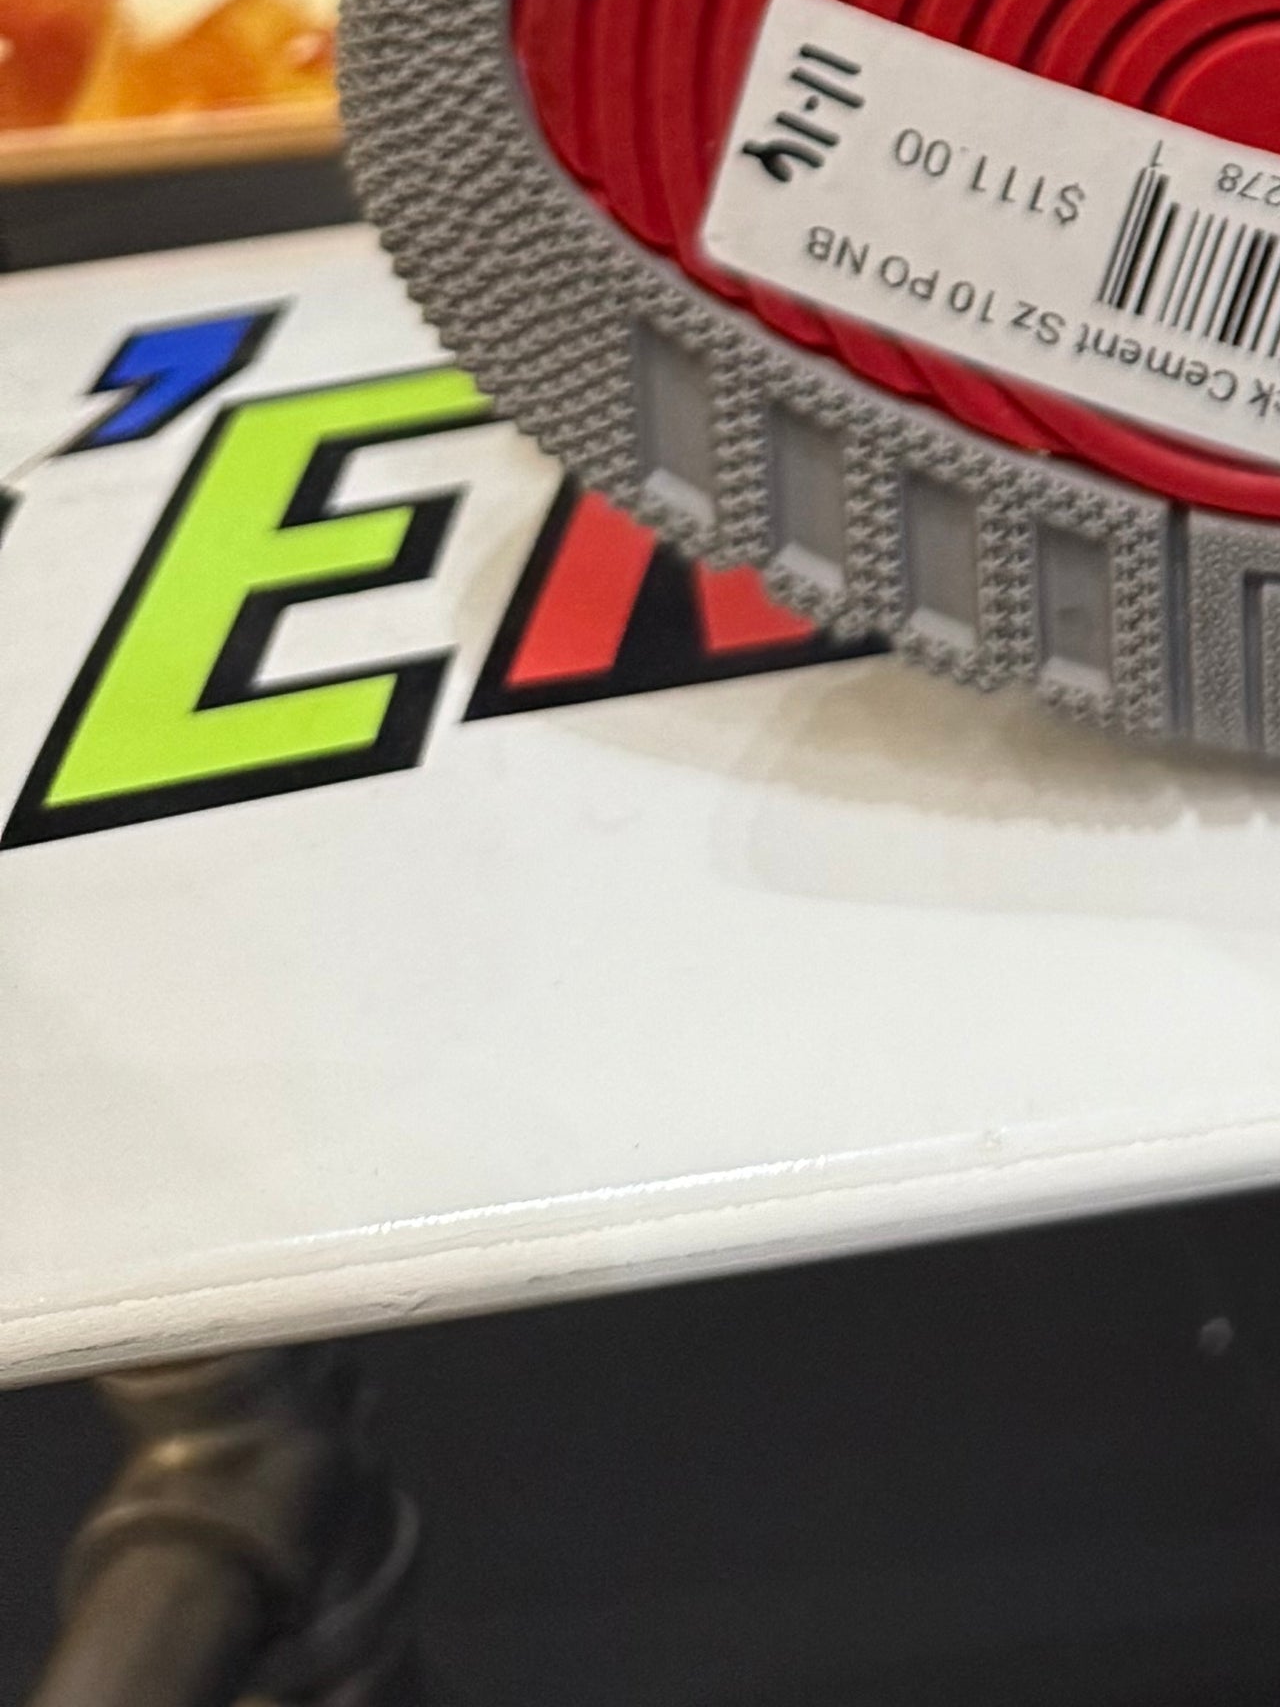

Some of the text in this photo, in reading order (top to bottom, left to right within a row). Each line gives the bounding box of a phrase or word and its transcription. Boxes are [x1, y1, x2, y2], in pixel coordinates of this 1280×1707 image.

[1149, 138, 1163, 169] 1
[892, 128, 1086, 228] $111.00
[803, 226, 870, 276] NB
[877, 255, 940, 303] PO
[946, 281, 995, 324] 10
[1010, 300, 1066, 347] Sz
[1074, 323, 1238, 404] Cement
